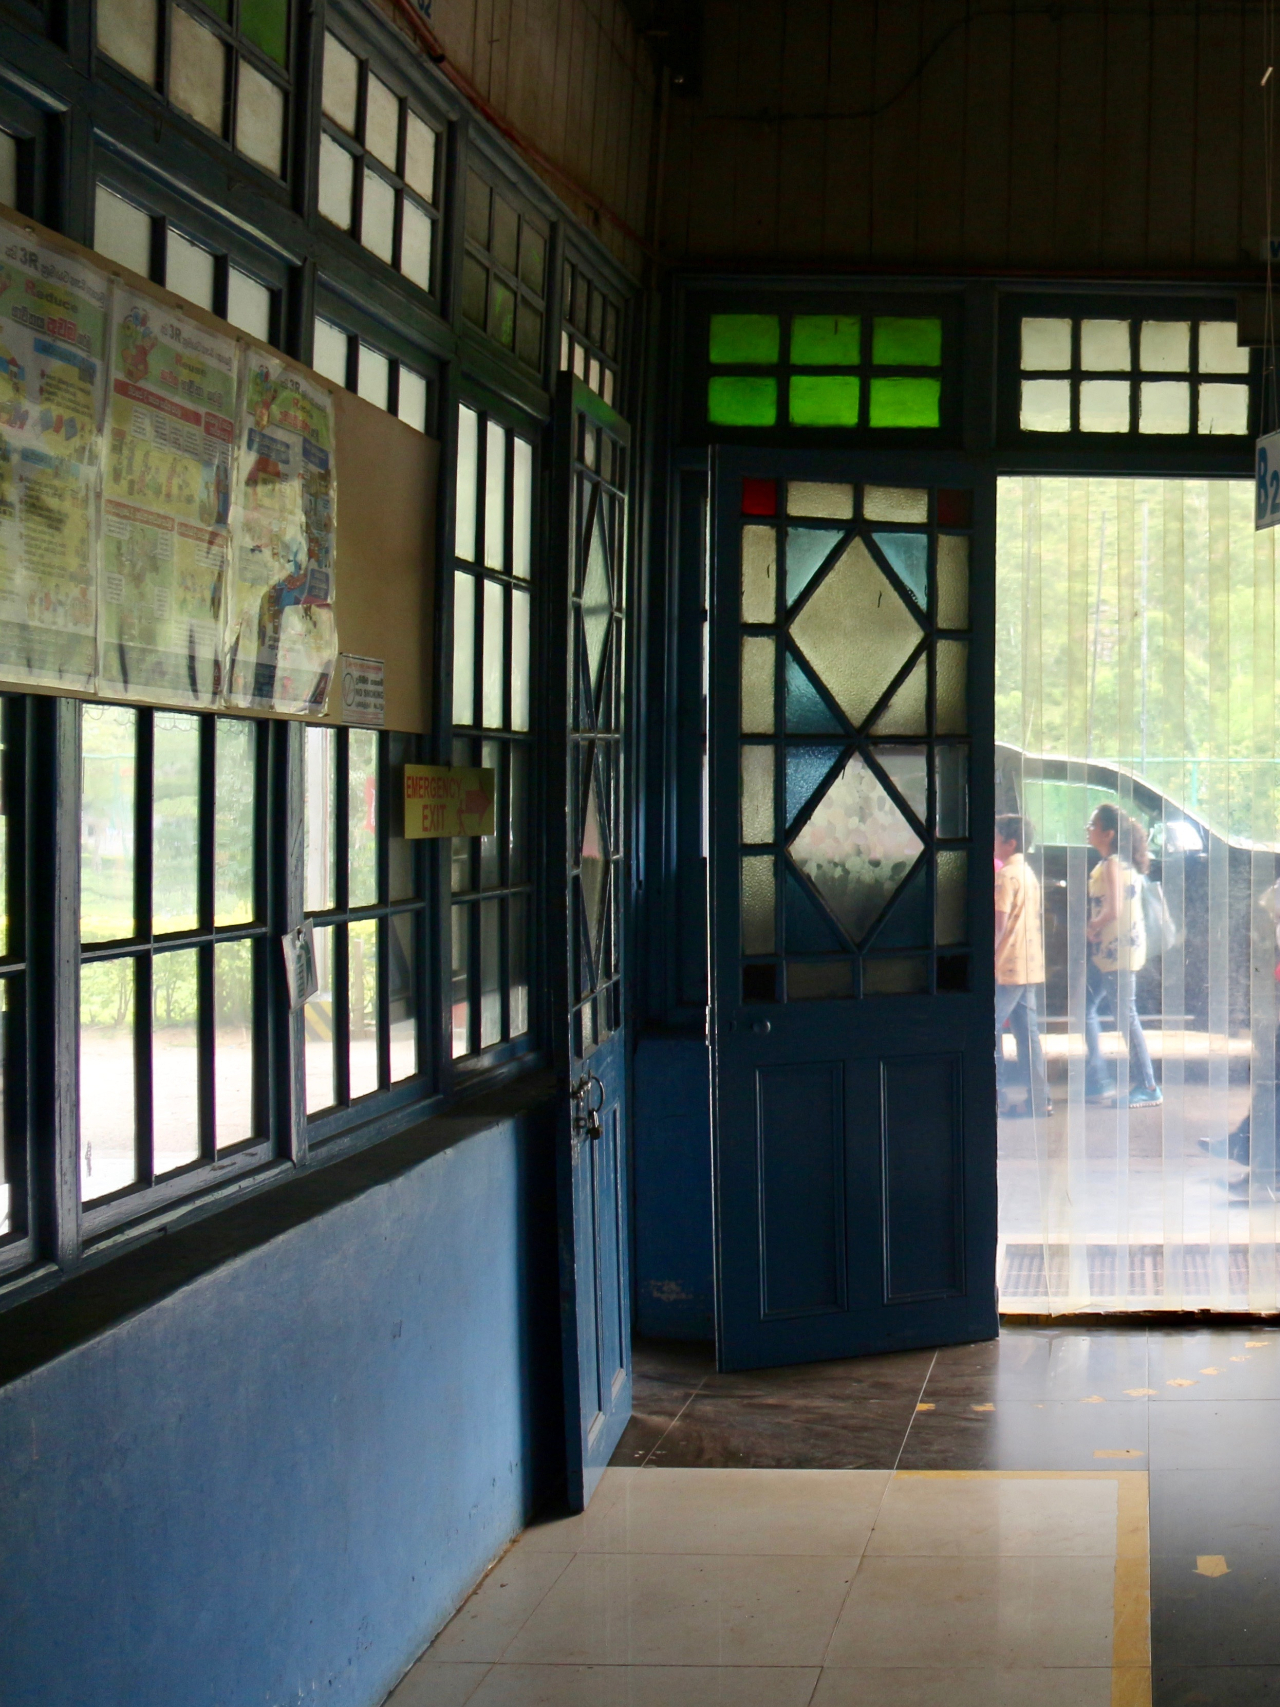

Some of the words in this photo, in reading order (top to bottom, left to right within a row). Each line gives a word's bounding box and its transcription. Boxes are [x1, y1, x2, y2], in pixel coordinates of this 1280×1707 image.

[19, 247, 39, 271] 3R
[25, 279, 79, 314] Reduce
[174, 353, 207, 377] Reuse
[1257, 446, 1280, 520] B2
[406, 776, 462, 799] EMERGENCY
[422, 804, 447, 832] EXIT
